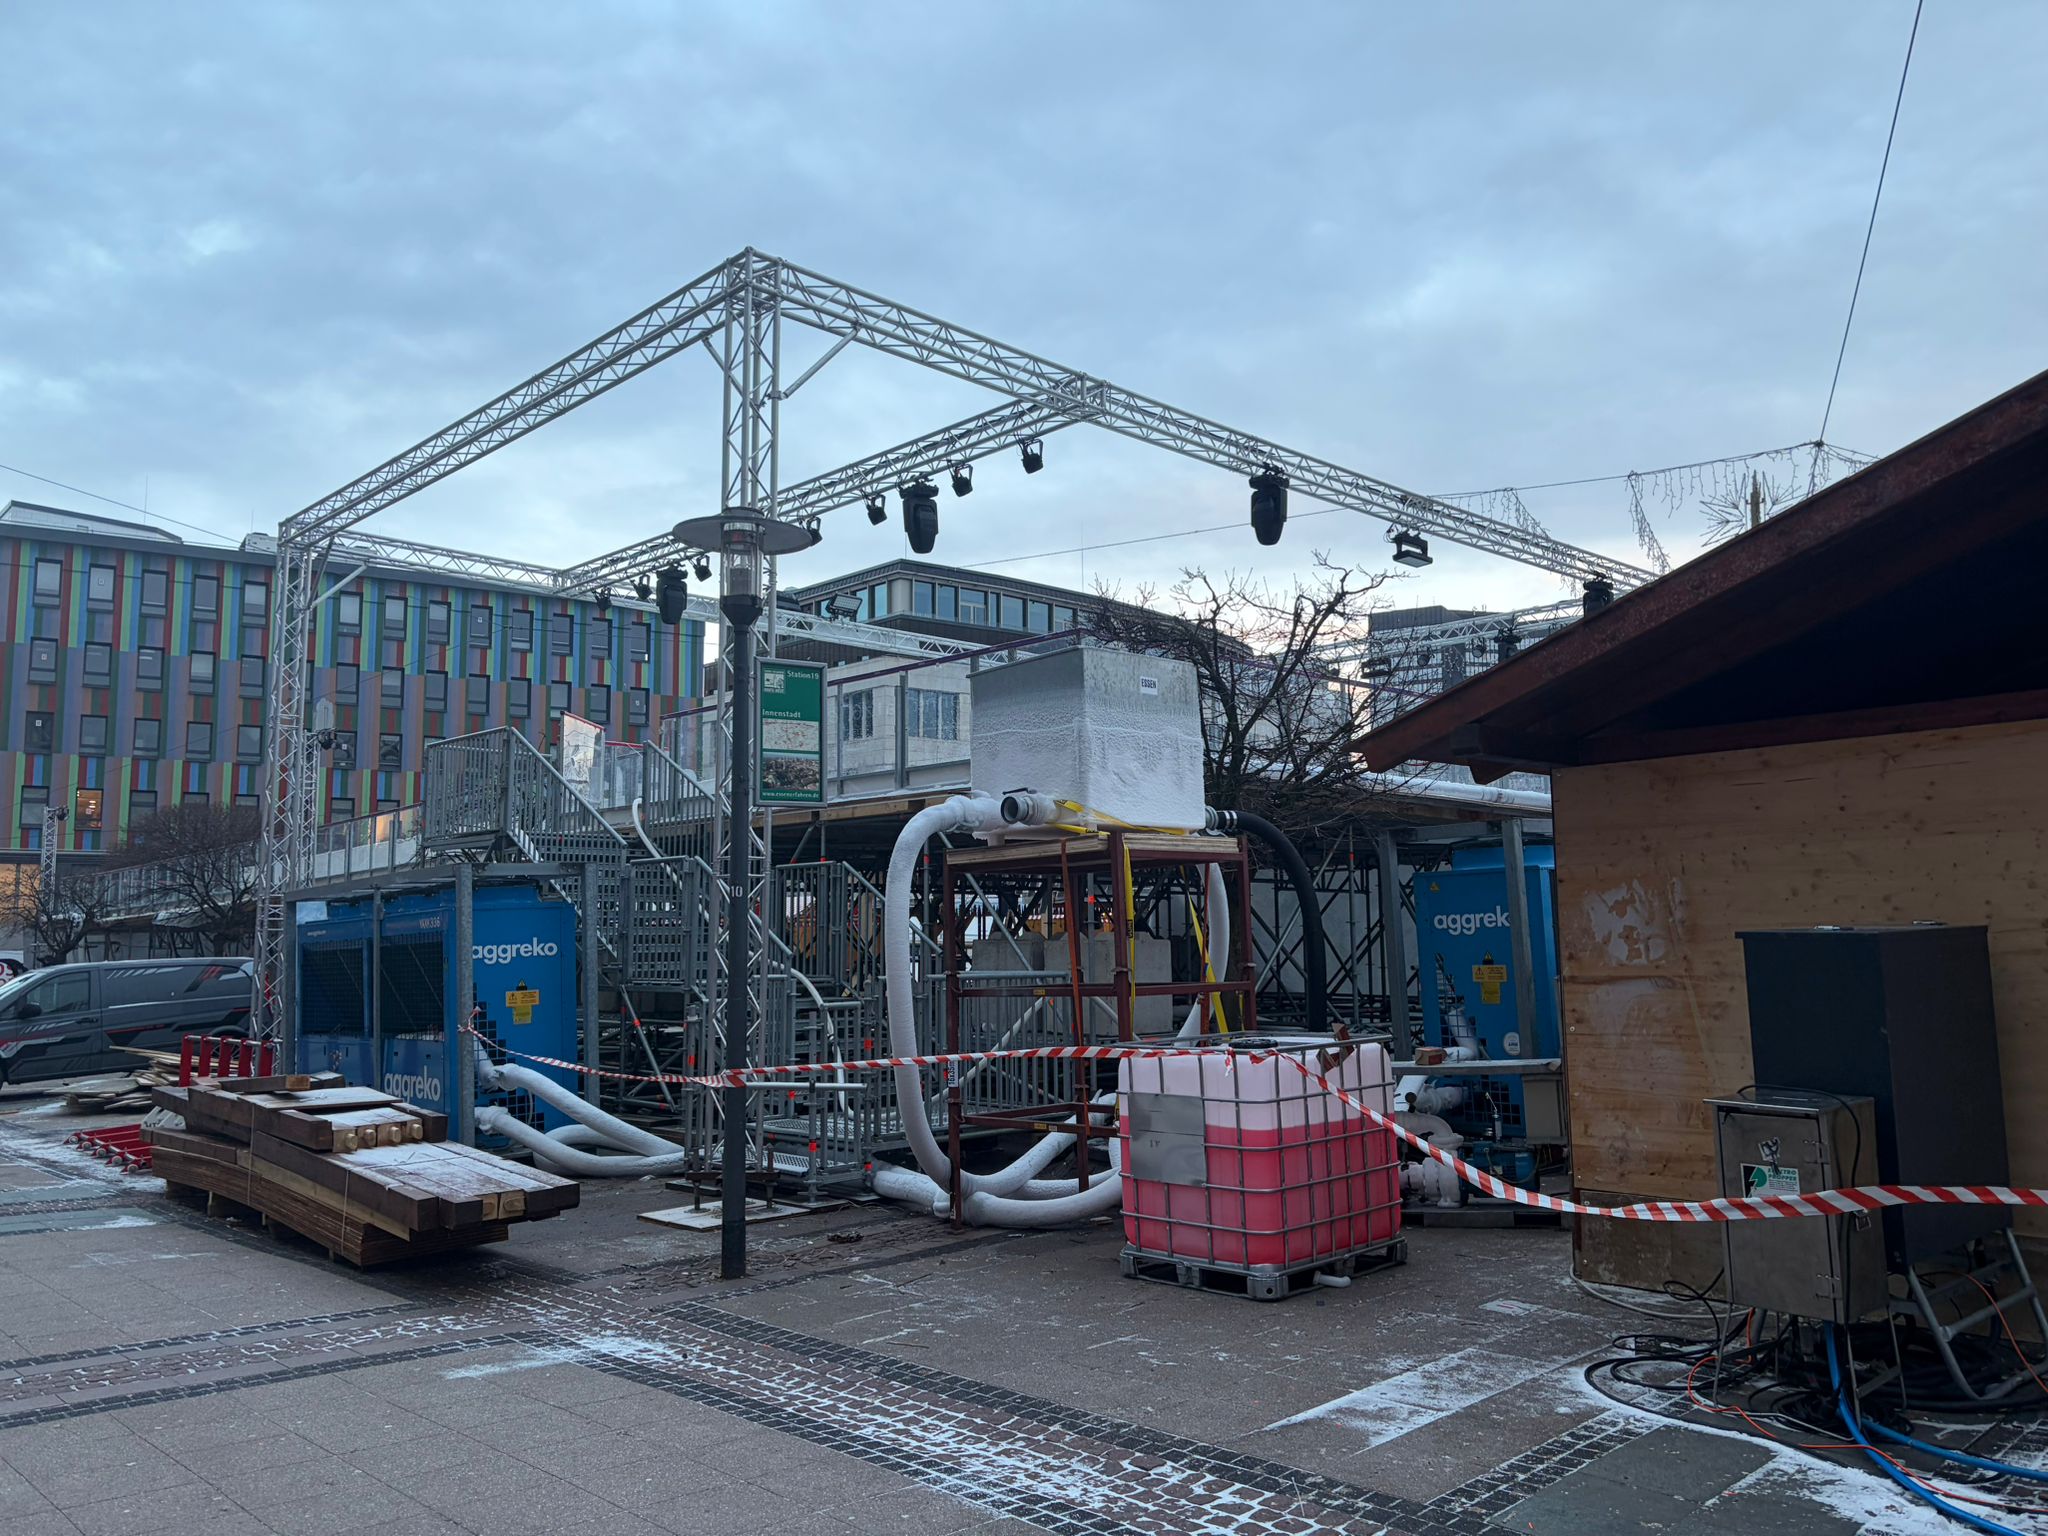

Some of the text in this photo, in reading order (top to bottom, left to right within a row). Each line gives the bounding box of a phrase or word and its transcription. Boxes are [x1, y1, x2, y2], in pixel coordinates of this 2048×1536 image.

[1141, 678, 1157, 689] ESSEN
[762, 709, 801, 718] Innenstadt
[731, 885, 743, 898] 10
[1433, 905, 1511, 936] aggrek
[472, 936, 558, 965] aggreko
[384, 1064, 441, 1103] aggreko
